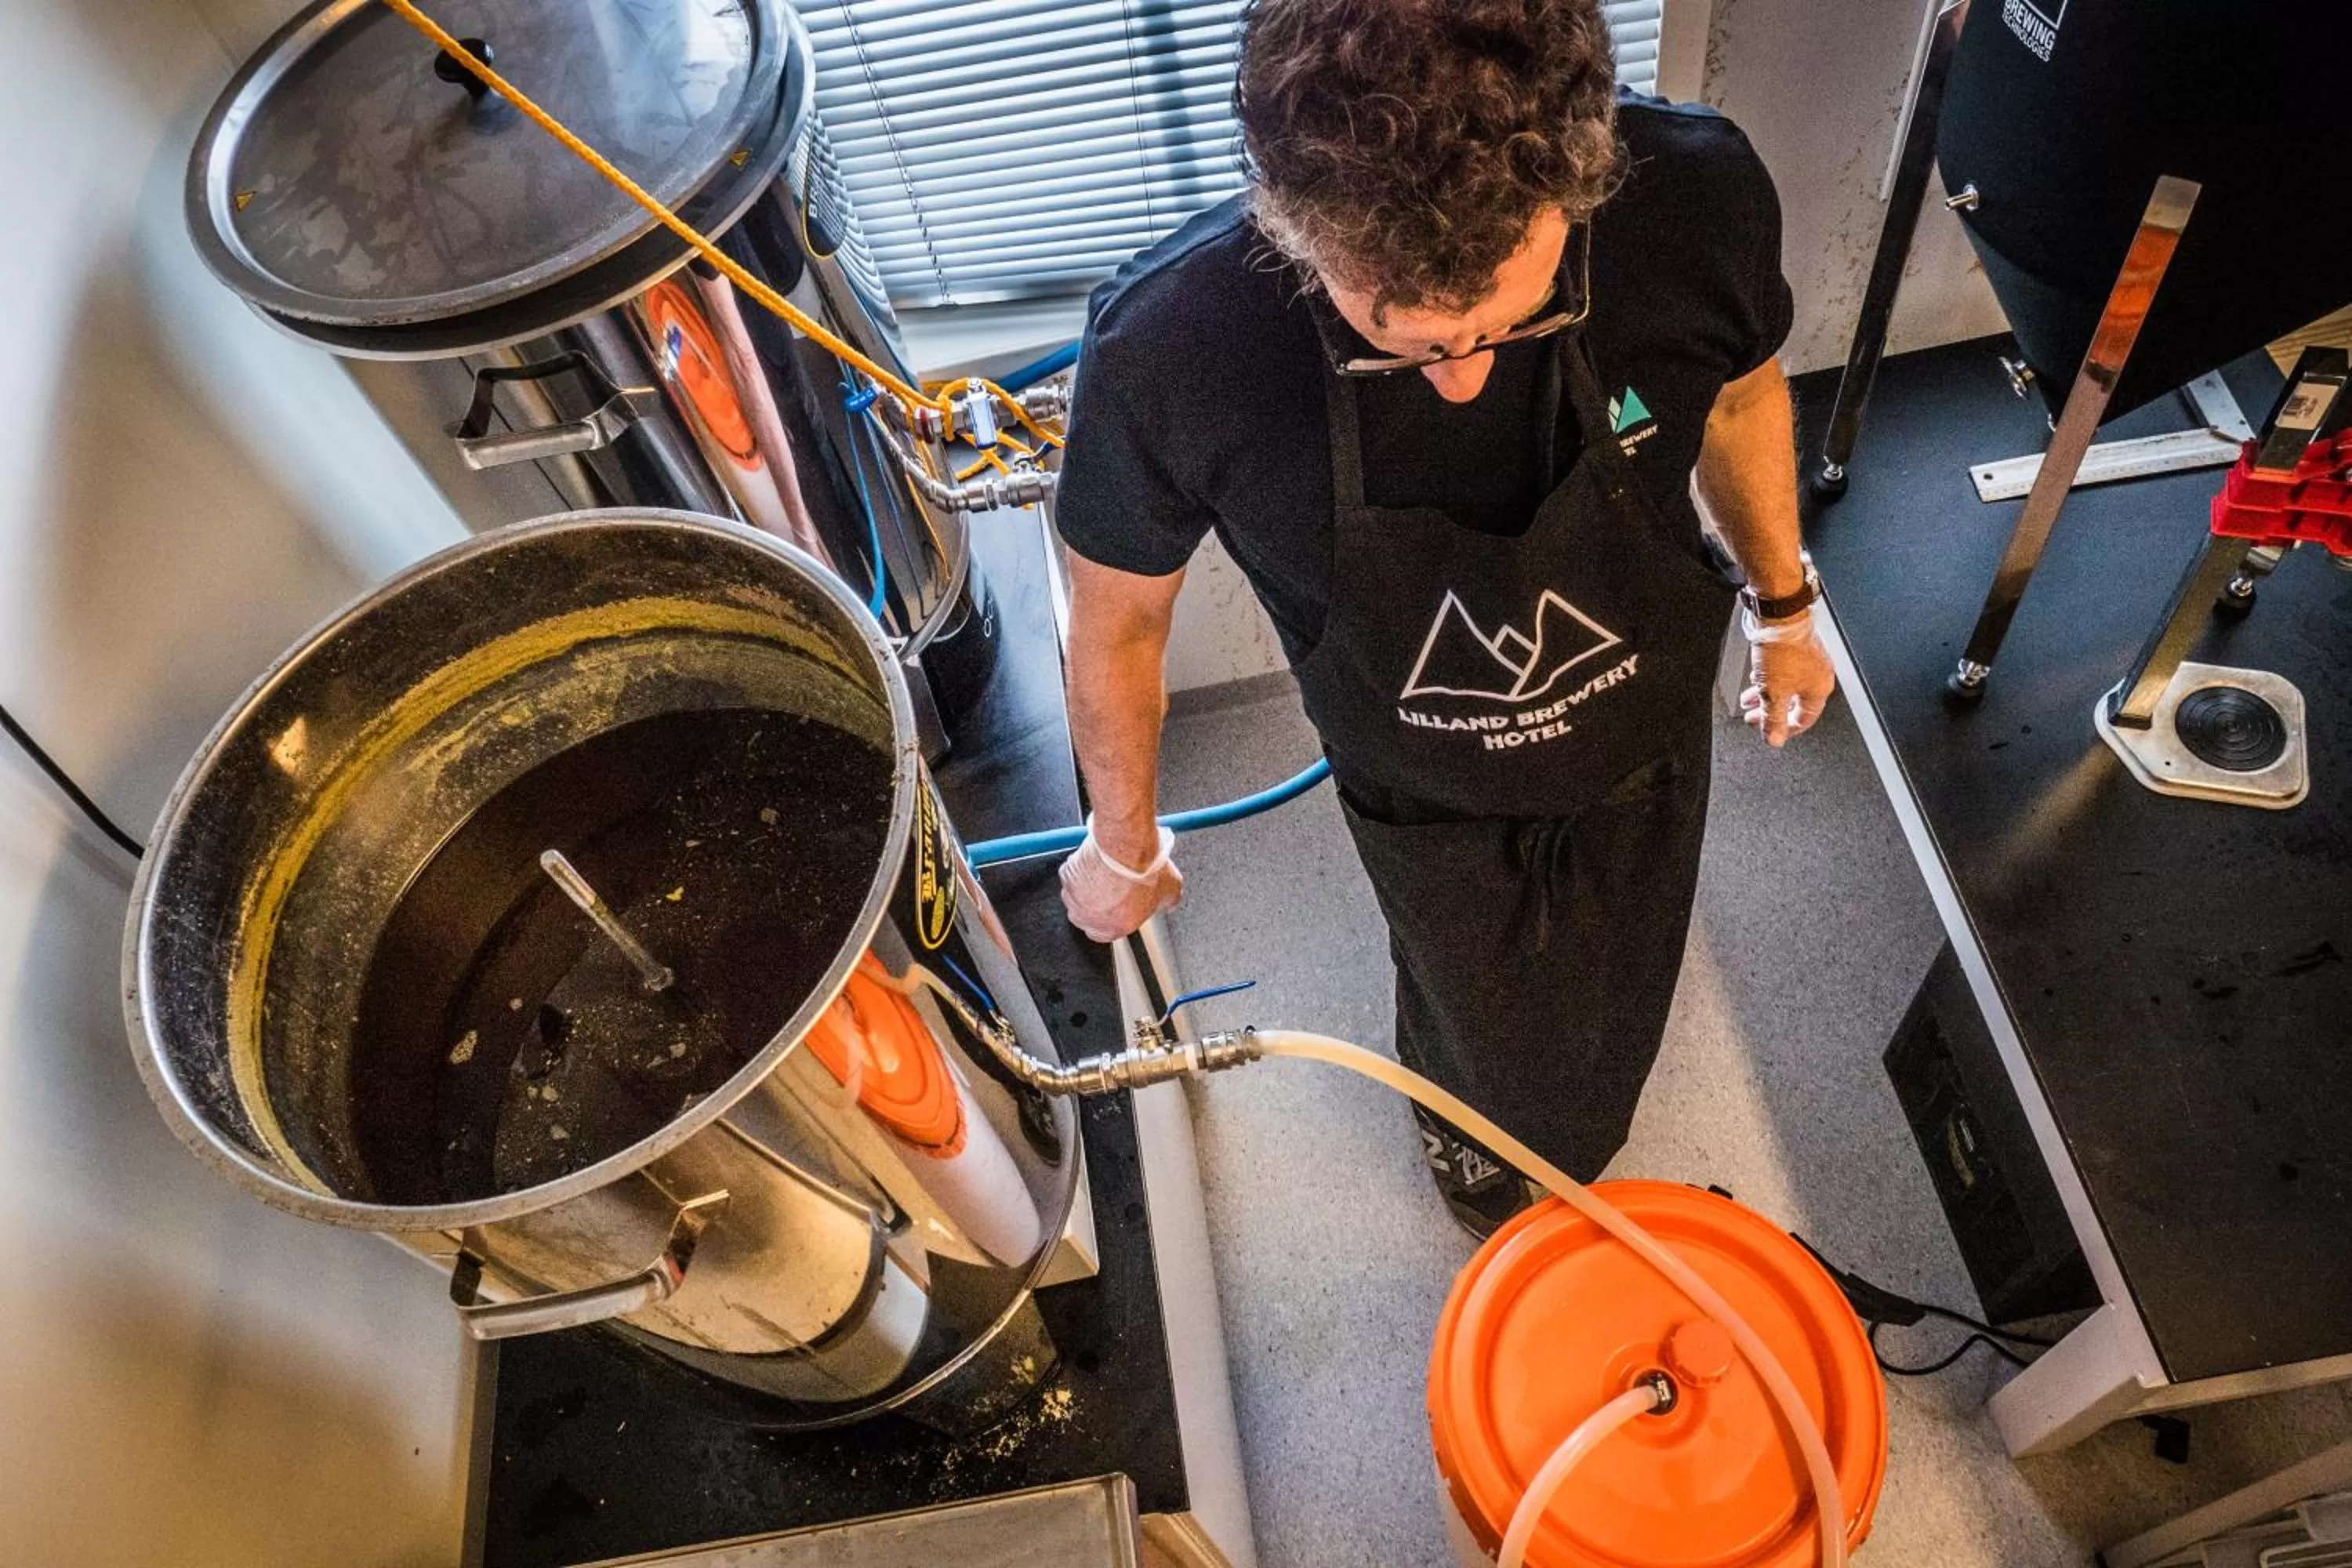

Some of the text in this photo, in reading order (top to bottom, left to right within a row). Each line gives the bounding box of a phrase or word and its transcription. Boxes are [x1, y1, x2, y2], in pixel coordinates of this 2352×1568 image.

[2002, 7, 2051, 62] TECHNOLOGIES
[1396, 654, 1639, 731] LILLAND BREWERY
[1483, 720, 1573, 750] HOTEL
